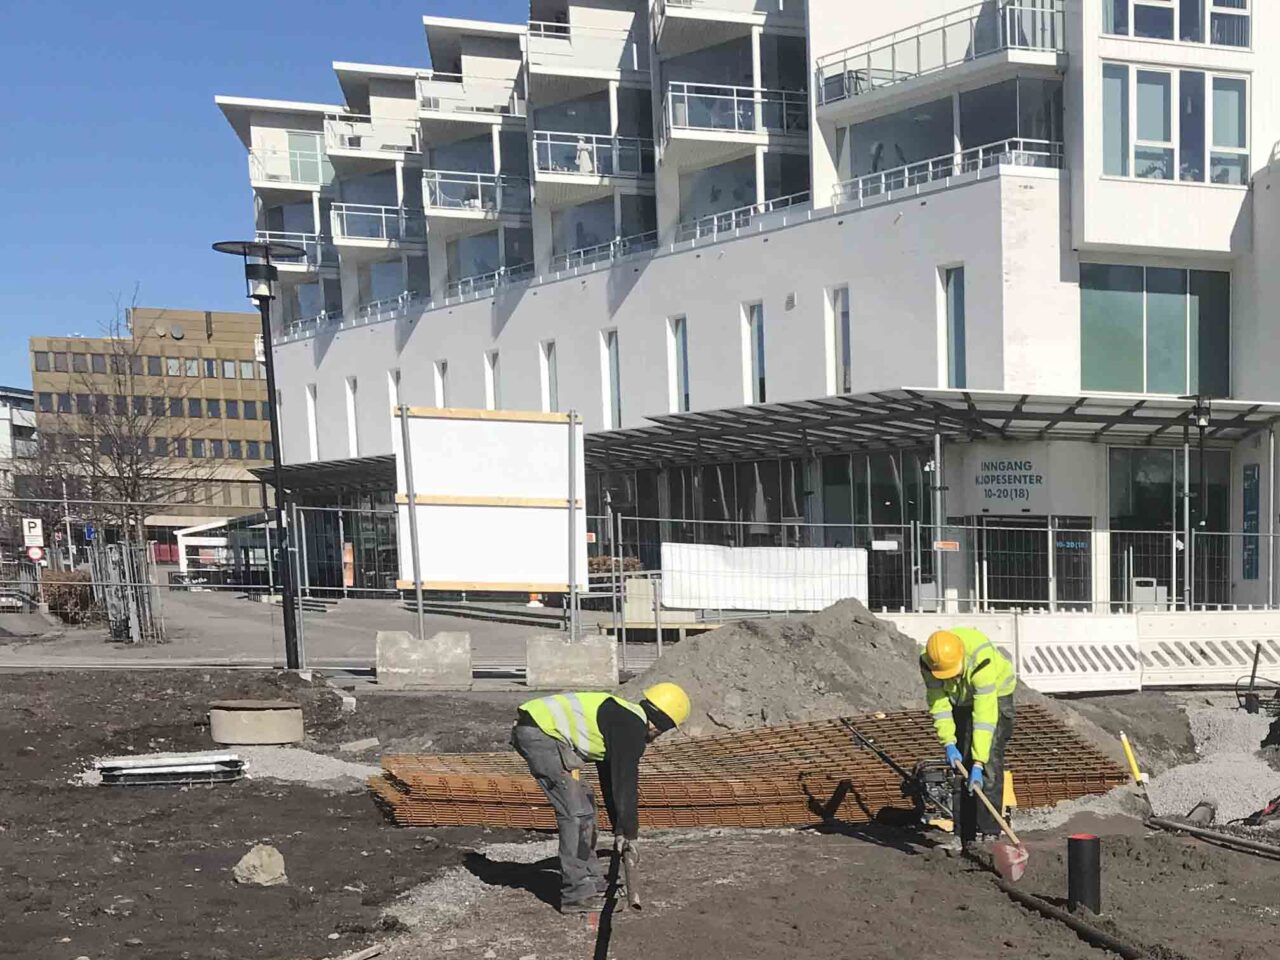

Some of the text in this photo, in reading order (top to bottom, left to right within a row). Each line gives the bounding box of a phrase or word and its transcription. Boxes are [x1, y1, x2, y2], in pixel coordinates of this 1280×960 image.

[980, 460, 1033, 472] INNGANG
[984, 488, 1030, 501] 10-20(18)
[28, 521, 37, 534] P
